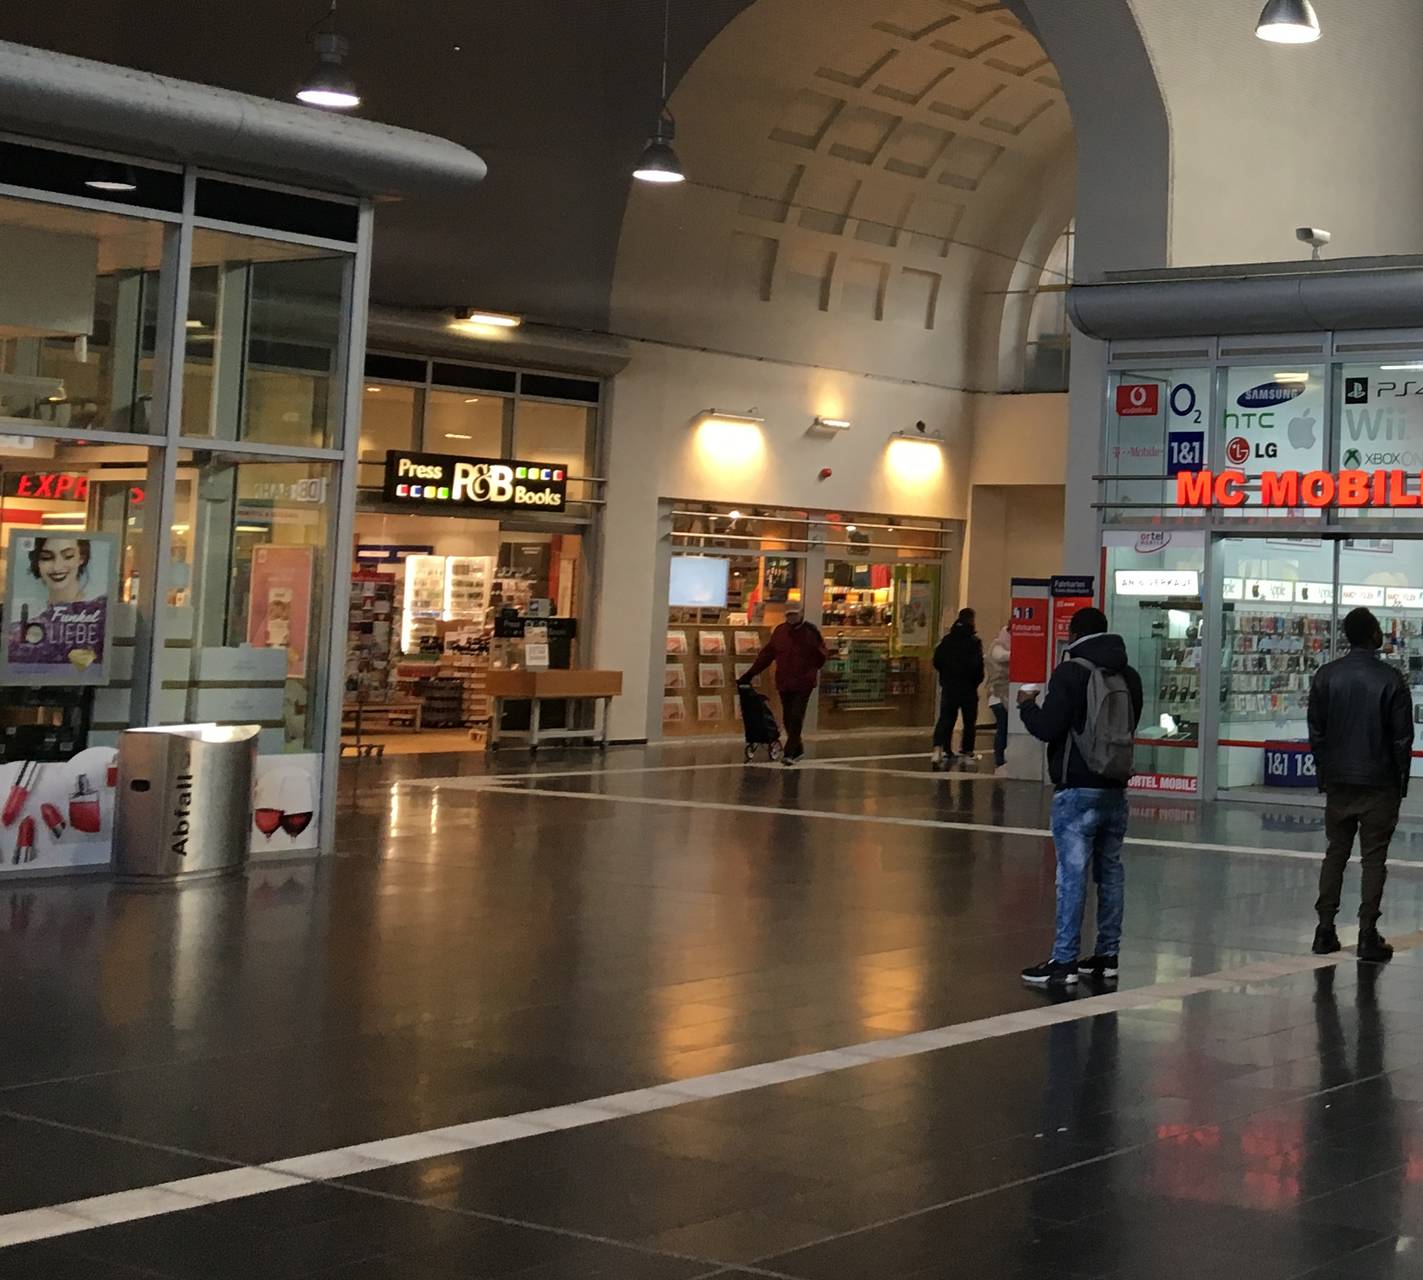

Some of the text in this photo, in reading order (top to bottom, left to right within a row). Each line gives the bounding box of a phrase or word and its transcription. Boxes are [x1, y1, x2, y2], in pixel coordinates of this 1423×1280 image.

[1246, 388, 1298, 400] SAMSUNG
[1345, 407, 1406, 441] Wii
[1171, 442, 1200, 464] 1&1
[1255, 443, 1277, 458] LG
[398, 459, 442, 479] Press
[16, 474, 88, 498] EXPR
[452, 462, 514, 502] P&B
[1176, 470, 1246, 507] MC
[515, 486, 561, 505] Books
[51, 606, 101, 623] Funkel
[48, 623, 97, 644] LIEBE
[1267, 752, 1317, 776] 1&1 1&
[1160, 777, 1197, 791] MOBILE
[171, 775, 193, 856] Abfall
